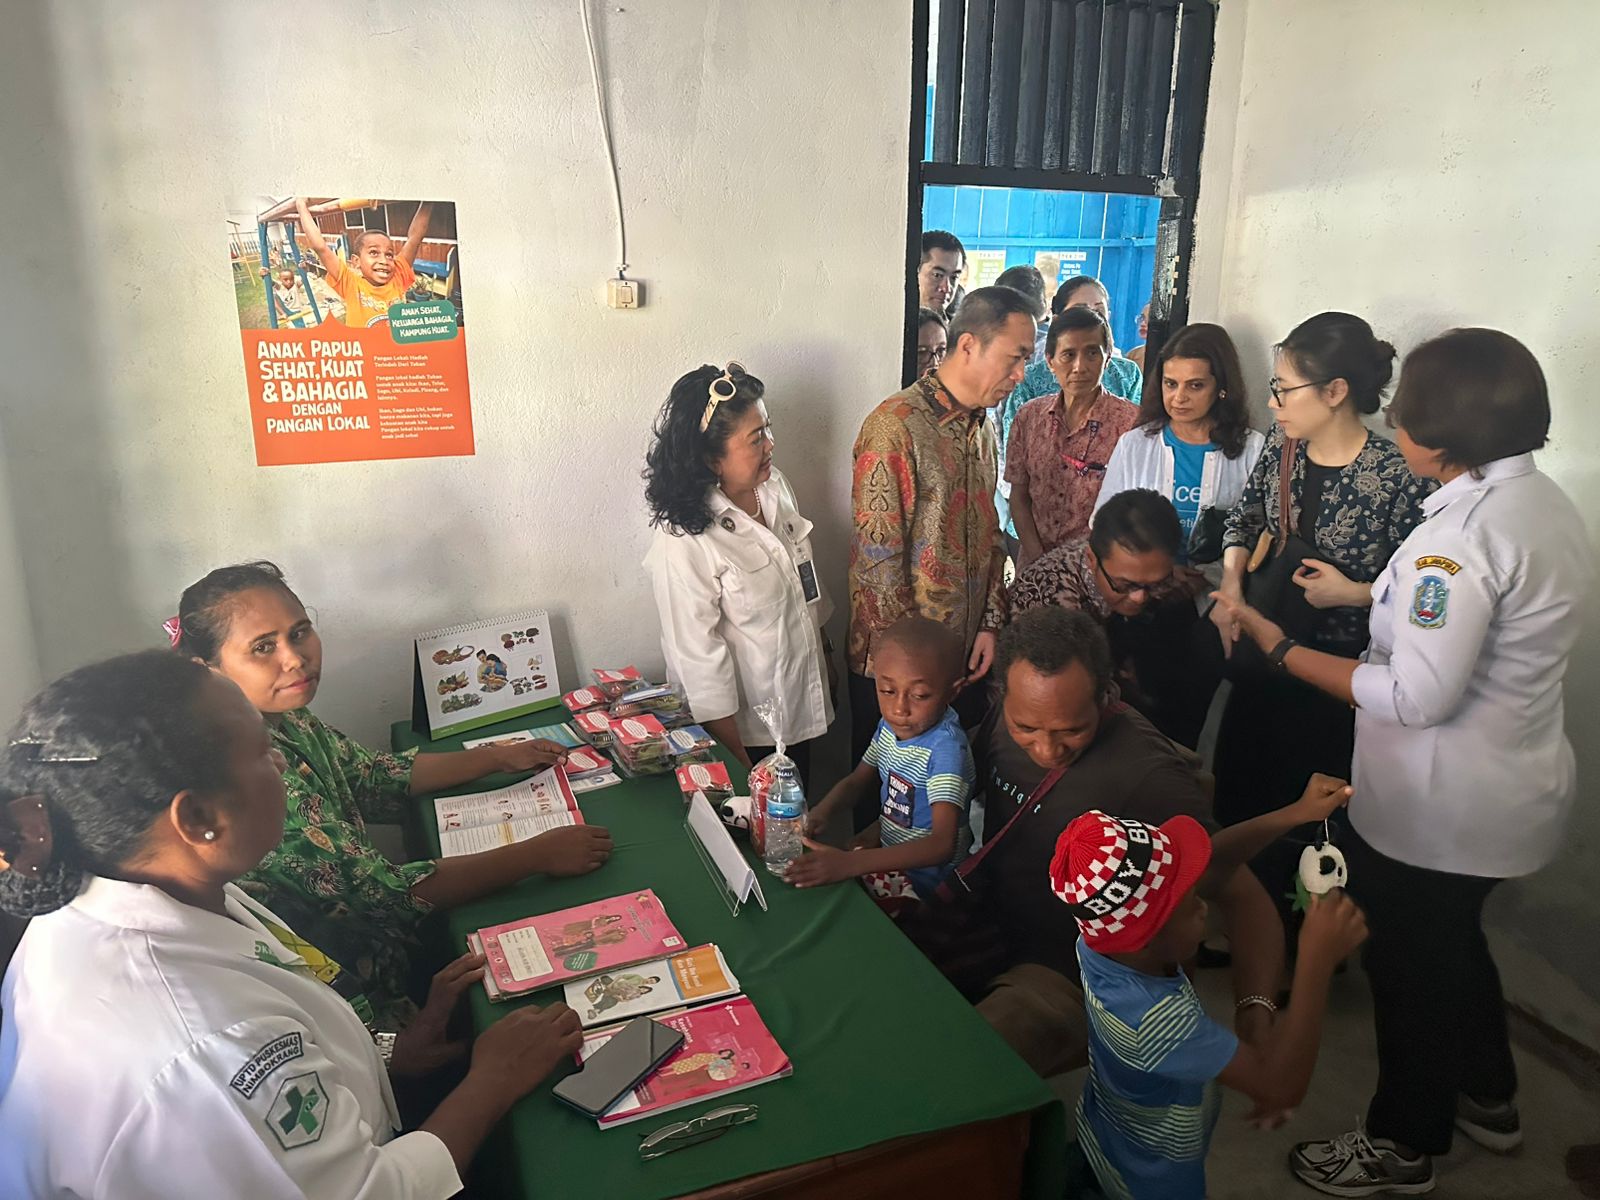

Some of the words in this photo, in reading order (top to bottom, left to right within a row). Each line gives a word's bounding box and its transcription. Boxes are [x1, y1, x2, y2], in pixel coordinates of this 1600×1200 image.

[401, 308, 419, 316] ANAK
[391, 319, 424, 327] KELUARGA
[400, 328, 431, 337] KAMPUNG
[257, 340, 305, 359] ANAK
[311, 340, 364, 358] PAPUA
[259, 360, 320, 380] SEHAT,
[320, 358, 364, 378] KUAT
[262, 382, 279, 403] &
[280, 380, 368, 402] BAHAGIA
[292, 402, 342, 416] DENGAN
[266, 418, 323, 433] PANGAN
[327, 416, 370, 431] LOKAL
[1175, 485, 1201, 503] ce
[992, 766, 1041, 814] Insigt
[1083, 858, 1144, 915] BOY
[233, 1063, 257, 1088] UPTD
[254, 1035, 299, 1067] PUSKESMAS
[242, 1046, 300, 1094] NIMBOKRANG
